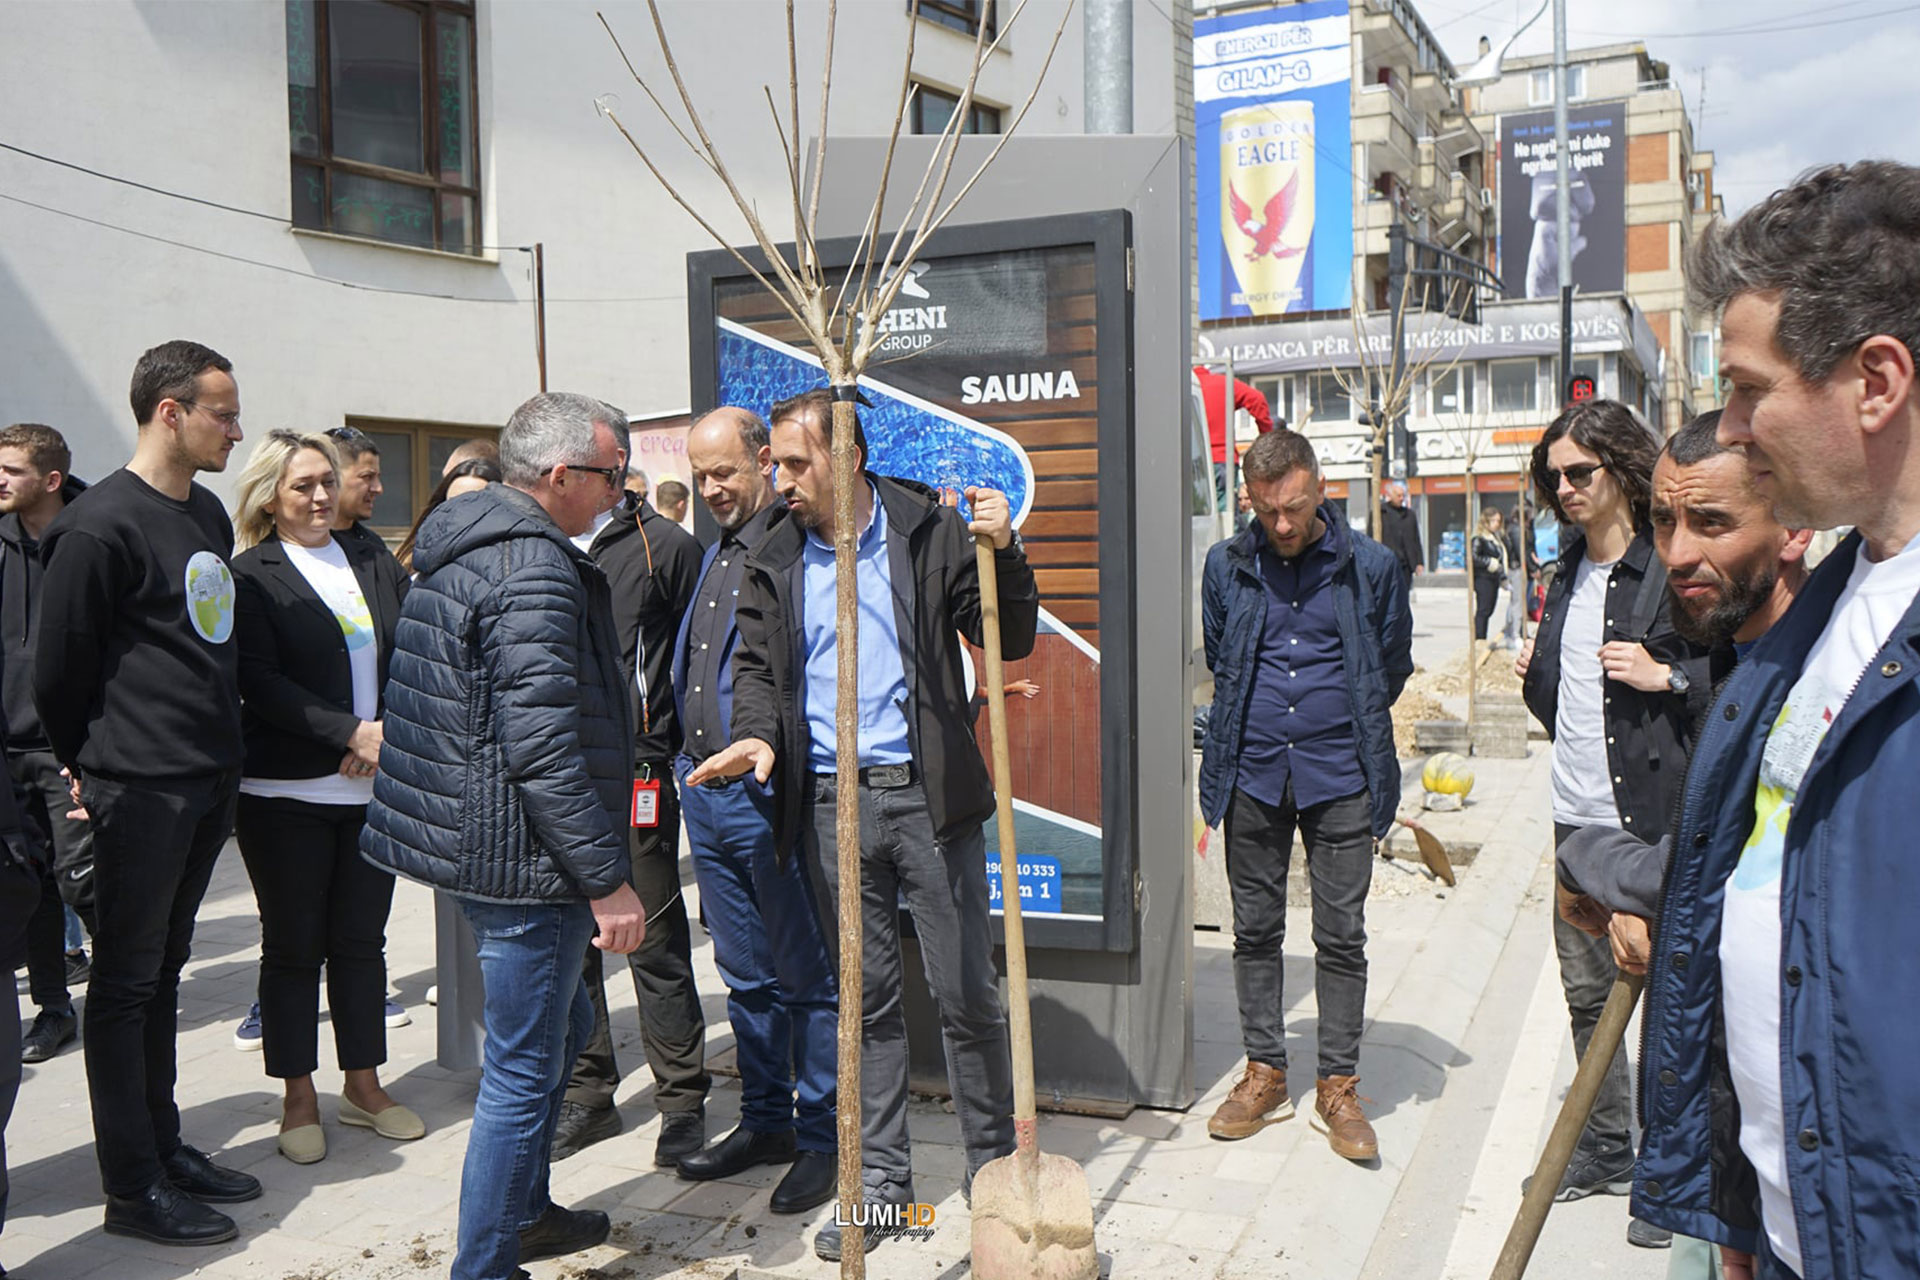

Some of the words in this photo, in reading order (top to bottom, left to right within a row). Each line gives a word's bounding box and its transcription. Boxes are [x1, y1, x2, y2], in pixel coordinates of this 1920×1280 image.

[1217, 59, 1312, 92] GILAN-G
[1237, 140, 1299, 167] EAGLE
[880, 333, 933, 351] GROUP
[1221, 340, 1307, 362] ALEANCA
[1312, 334, 1350, 356] PËR
[1355, 324, 1495, 353] ARDMËRINË
[1501, 325, 1514, 343] E
[960, 370, 1081, 405] SAUNA
[1573, 379, 1592, 400] 63
[1032, 864, 1056, 877] 333
[1040, 882, 1051, 899] 1
